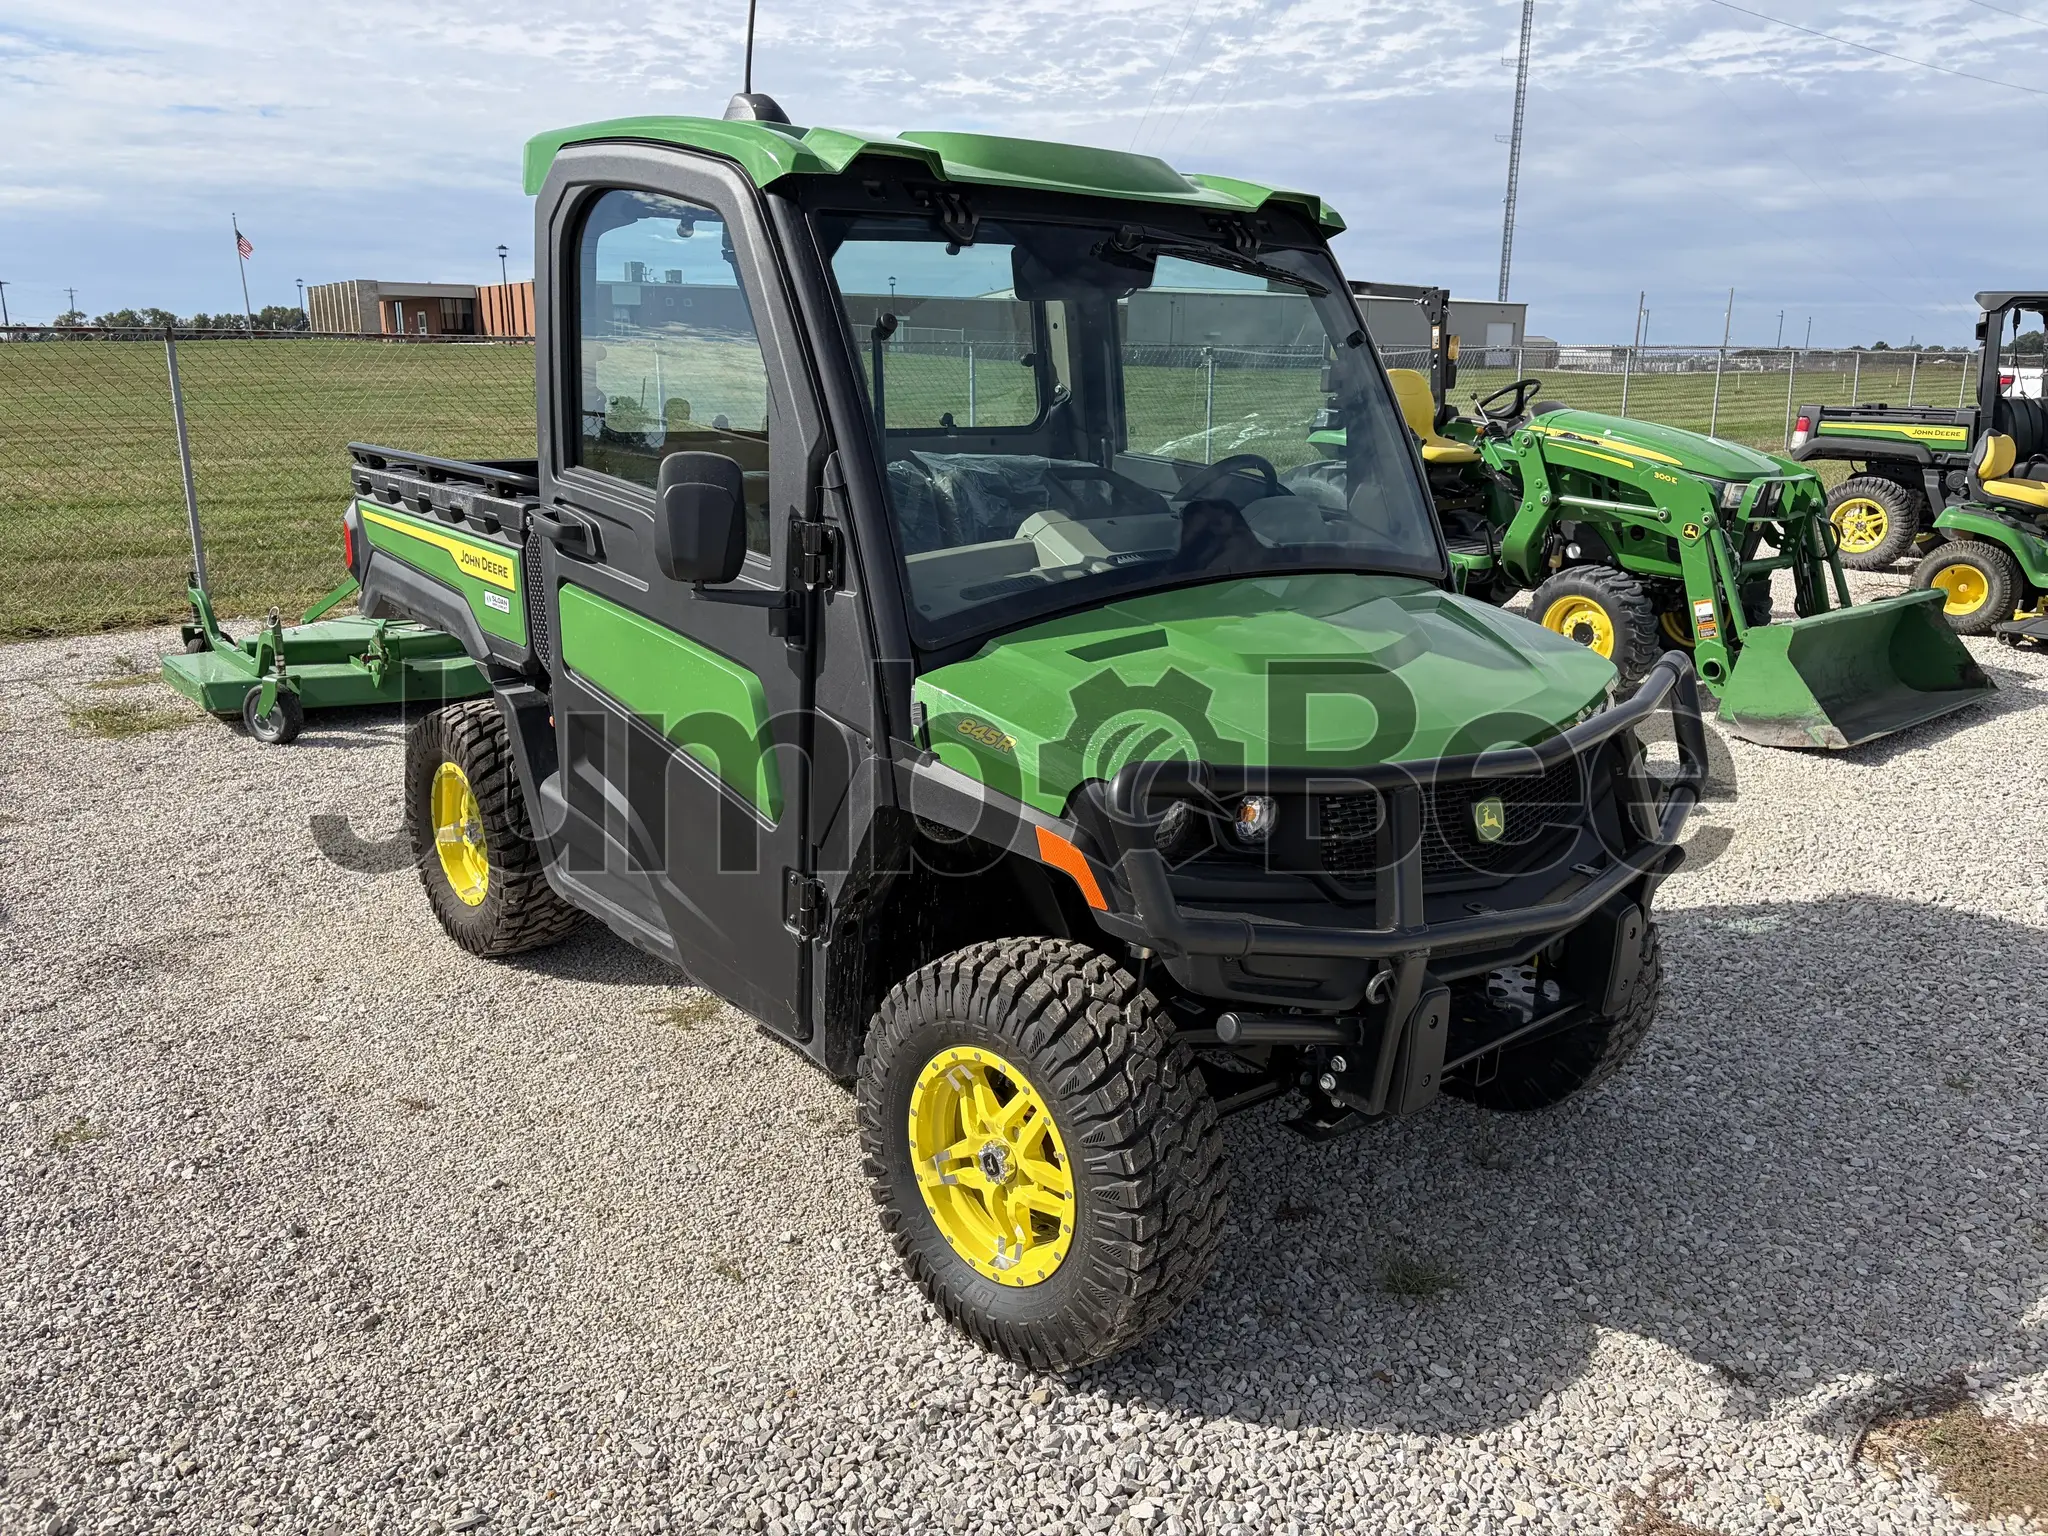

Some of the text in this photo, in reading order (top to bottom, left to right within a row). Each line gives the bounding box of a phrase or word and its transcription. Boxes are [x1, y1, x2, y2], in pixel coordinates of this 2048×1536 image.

[1912, 429, 1961, 438] JOHN DEERE
[1653, 471, 1678, 486] 300E
[460, 549, 509, 579] JOHN DEERE
[957, 717, 1018, 755] 845R
